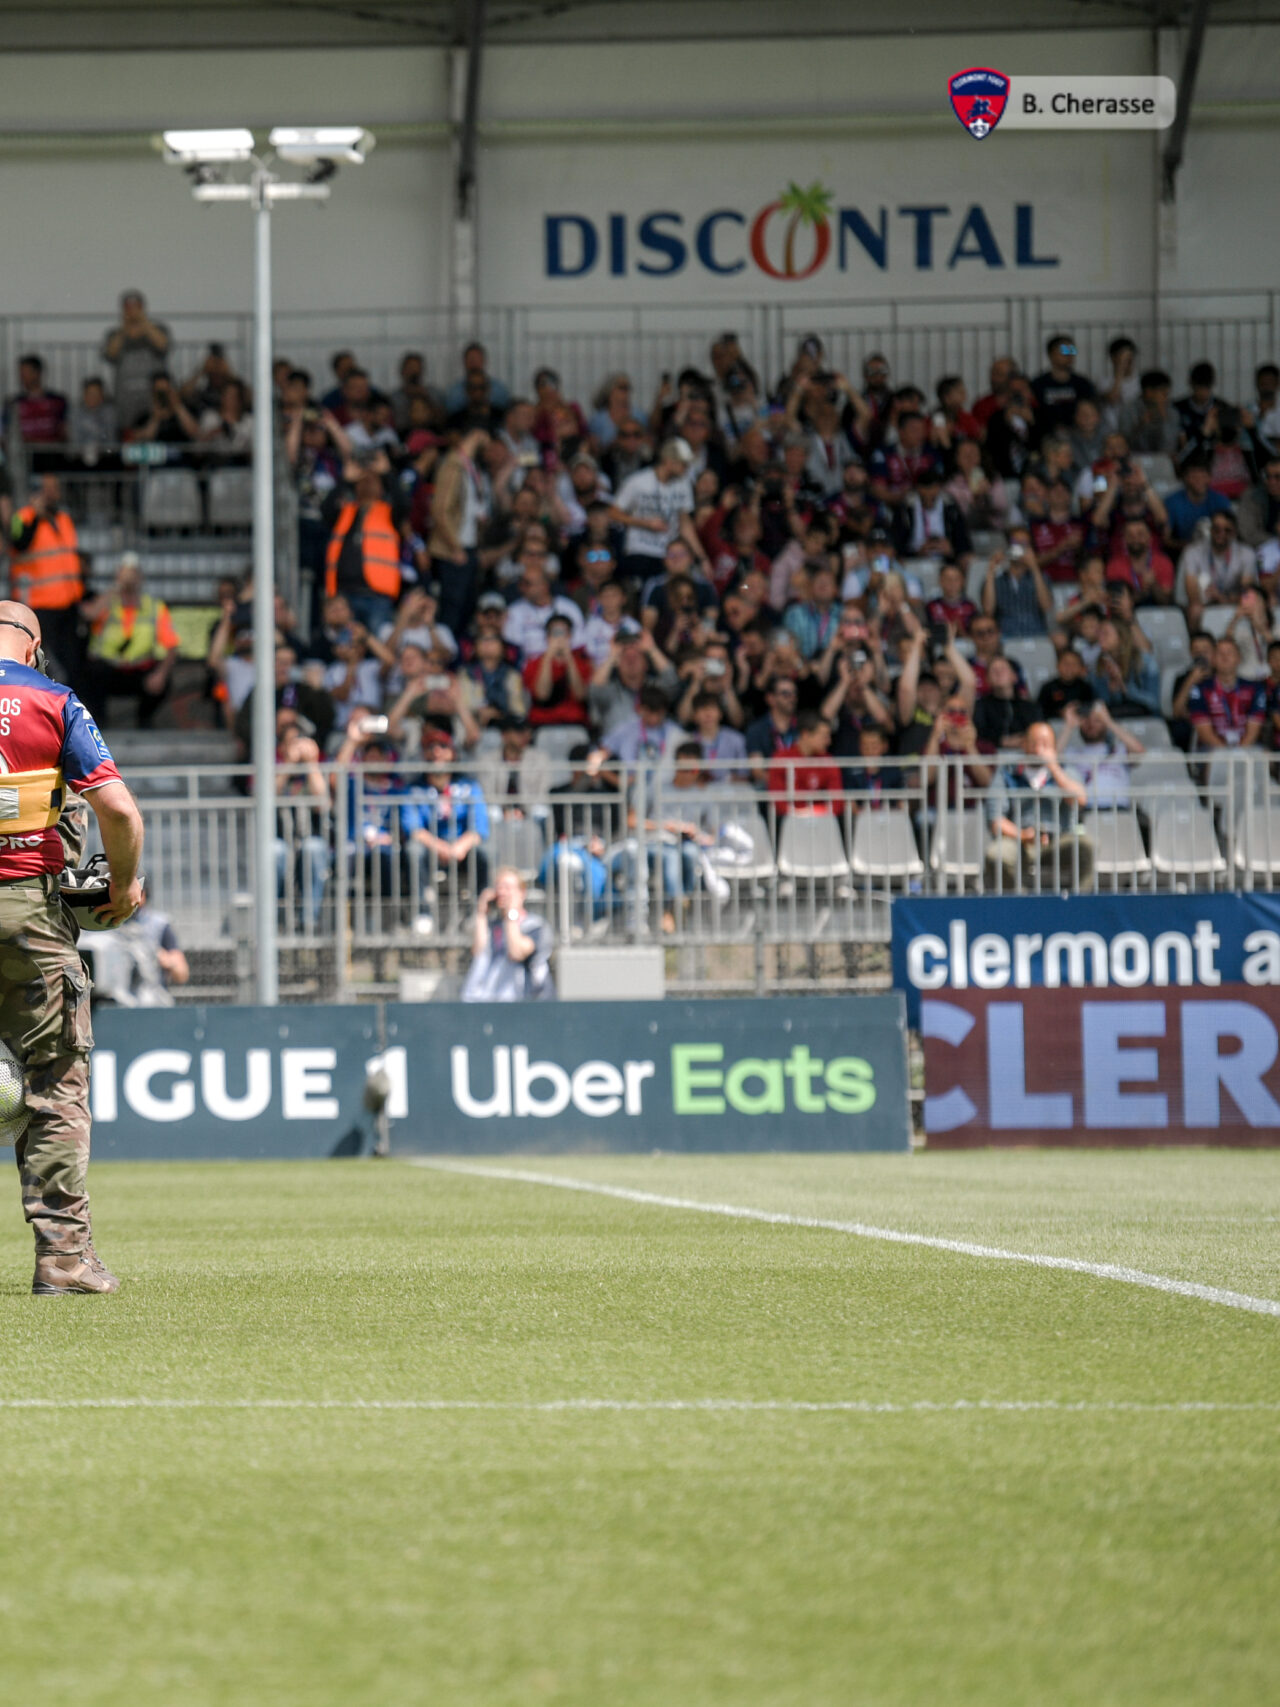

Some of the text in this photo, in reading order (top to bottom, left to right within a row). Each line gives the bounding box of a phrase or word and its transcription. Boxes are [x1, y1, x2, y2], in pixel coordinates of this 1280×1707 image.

[542, 197, 1062, 281] DISCONTAL
[906, 919, 1221, 990] clermont
[365, 1045, 409, 1119] 1
[450, 1044, 655, 1118] Uber
[671, 1043, 877, 1115] Eats
